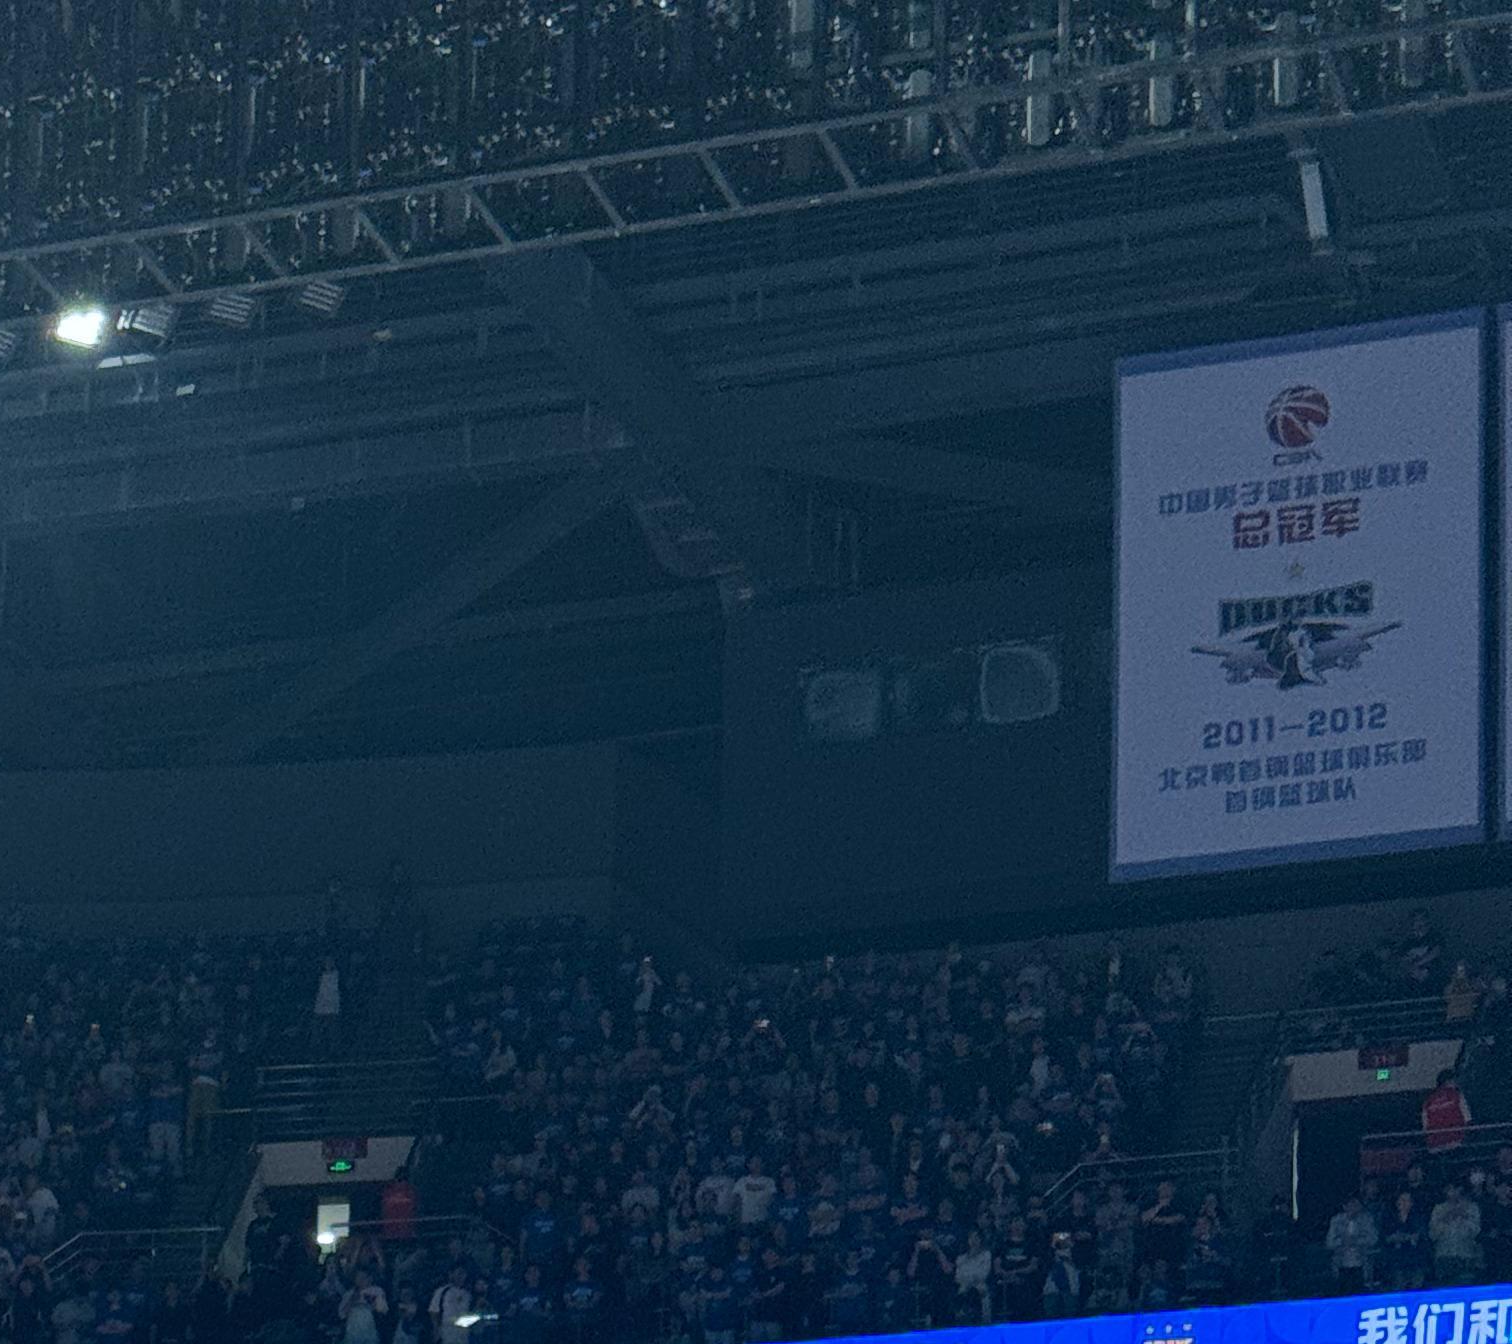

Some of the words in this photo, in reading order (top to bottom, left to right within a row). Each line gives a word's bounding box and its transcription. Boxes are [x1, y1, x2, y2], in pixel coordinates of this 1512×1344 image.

[1232, 497, 1360, 550] 总冠军
[1218, 580, 1374, 637] DUCKS
